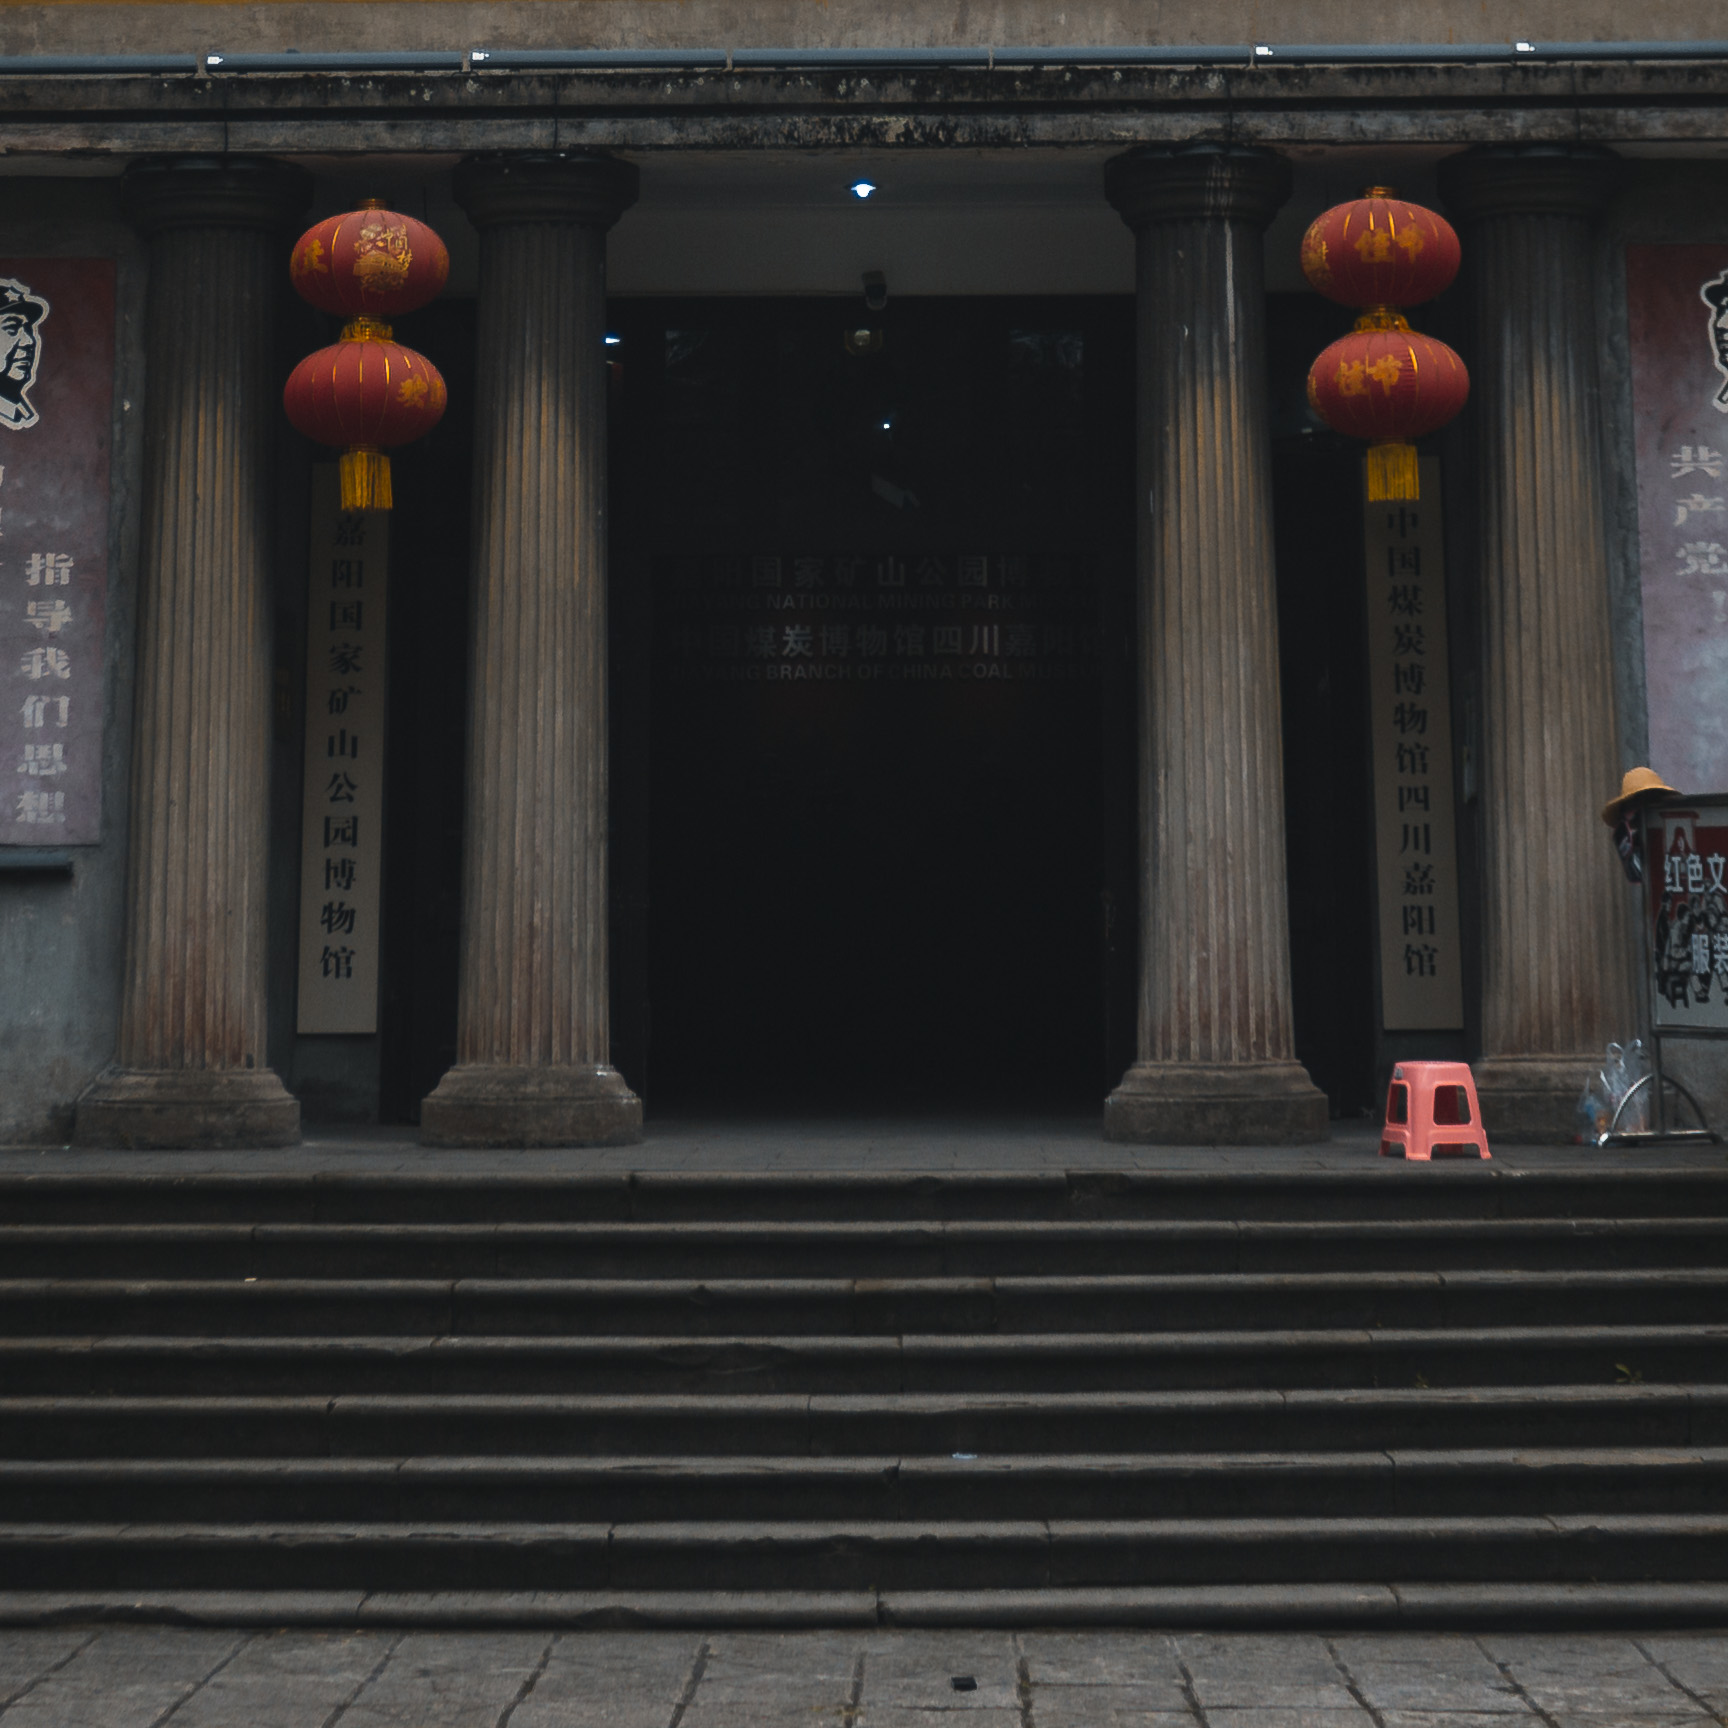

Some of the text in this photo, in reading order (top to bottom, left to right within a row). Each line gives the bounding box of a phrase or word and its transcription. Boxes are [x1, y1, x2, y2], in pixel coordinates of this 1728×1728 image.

[16, 552, 74, 825] 指导我们思想
[766, 663, 852, 681] BRANCH
[958, 663, 1014, 681] COAL
[961, 593, 1016, 610] PARK
[319, 515, 364, 980] 嘉阳国家矿山公园博物馆
[1385, 505, 1439, 978] 中国煤炭博物馆四川嘉阳馆
